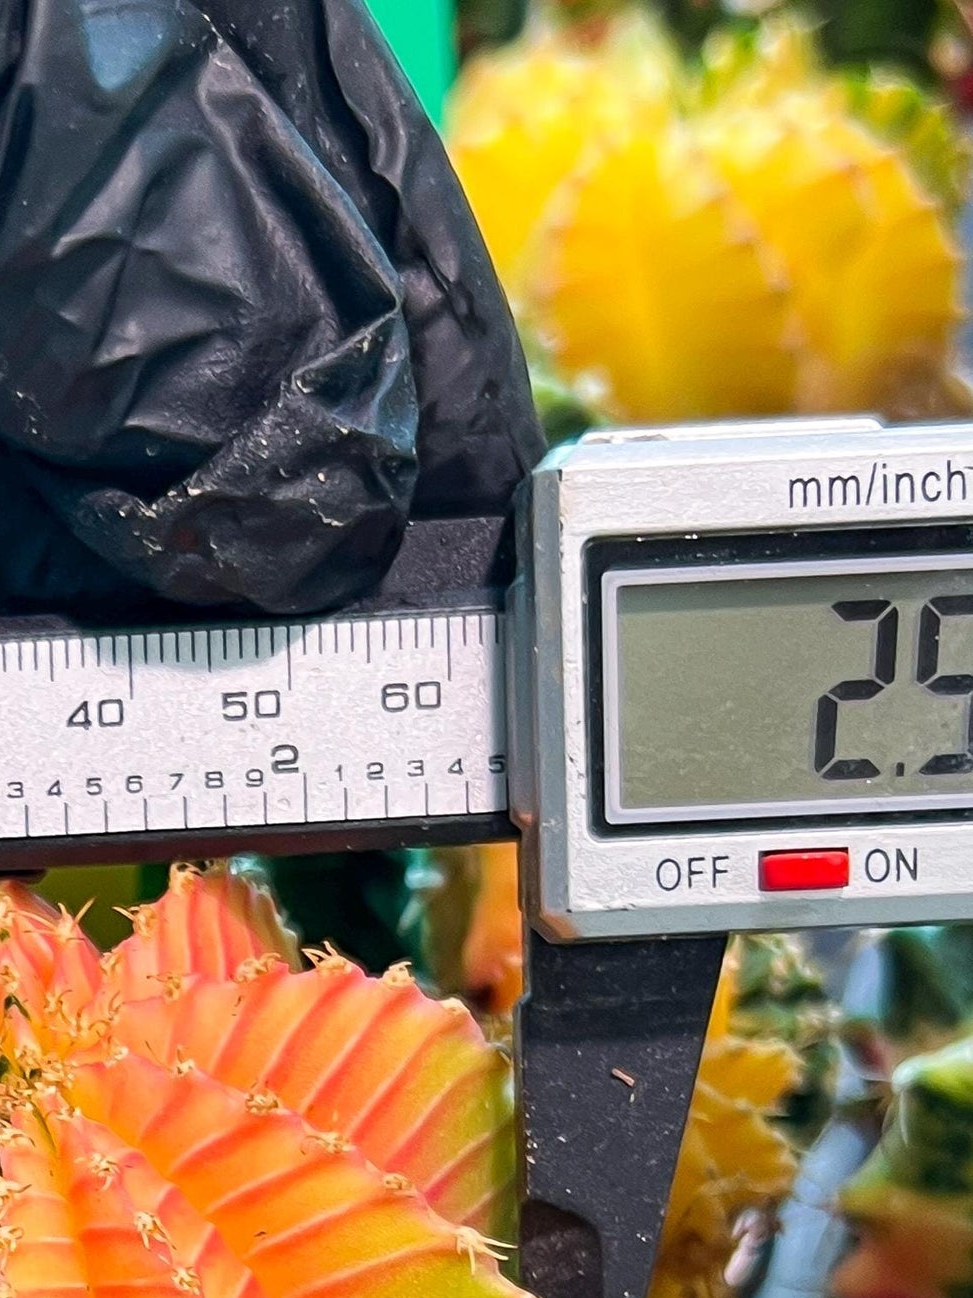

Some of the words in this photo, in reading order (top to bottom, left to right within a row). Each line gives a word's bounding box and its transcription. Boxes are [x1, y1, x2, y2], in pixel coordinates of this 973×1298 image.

[788, 460, 967, 508] mm/inch
[66, 698, 124, 731] 40
[221, 689, 281, 722] 50
[380, 681, 442, 713] 60
[7, 781, 24, 799] 3
[47, 779, 62, 797] 4
[85, 777, 103, 796] 5
[126, 775, 144, 794] 6
[169, 773, 185, 791] 7
[204, 771, 225, 789] 8
[245, 768, 264, 788] 9
[270, 744, 300, 775] 2
[334, 764, 343, 782] 1
[366, 761, 385, 780] 2
[407, 759, 425, 777] 3
[448, 758, 464, 775] 4
[488, 754, 506, 774] 5
[655, 855, 729, 891] OFF
[864, 847, 918, 882] ON
